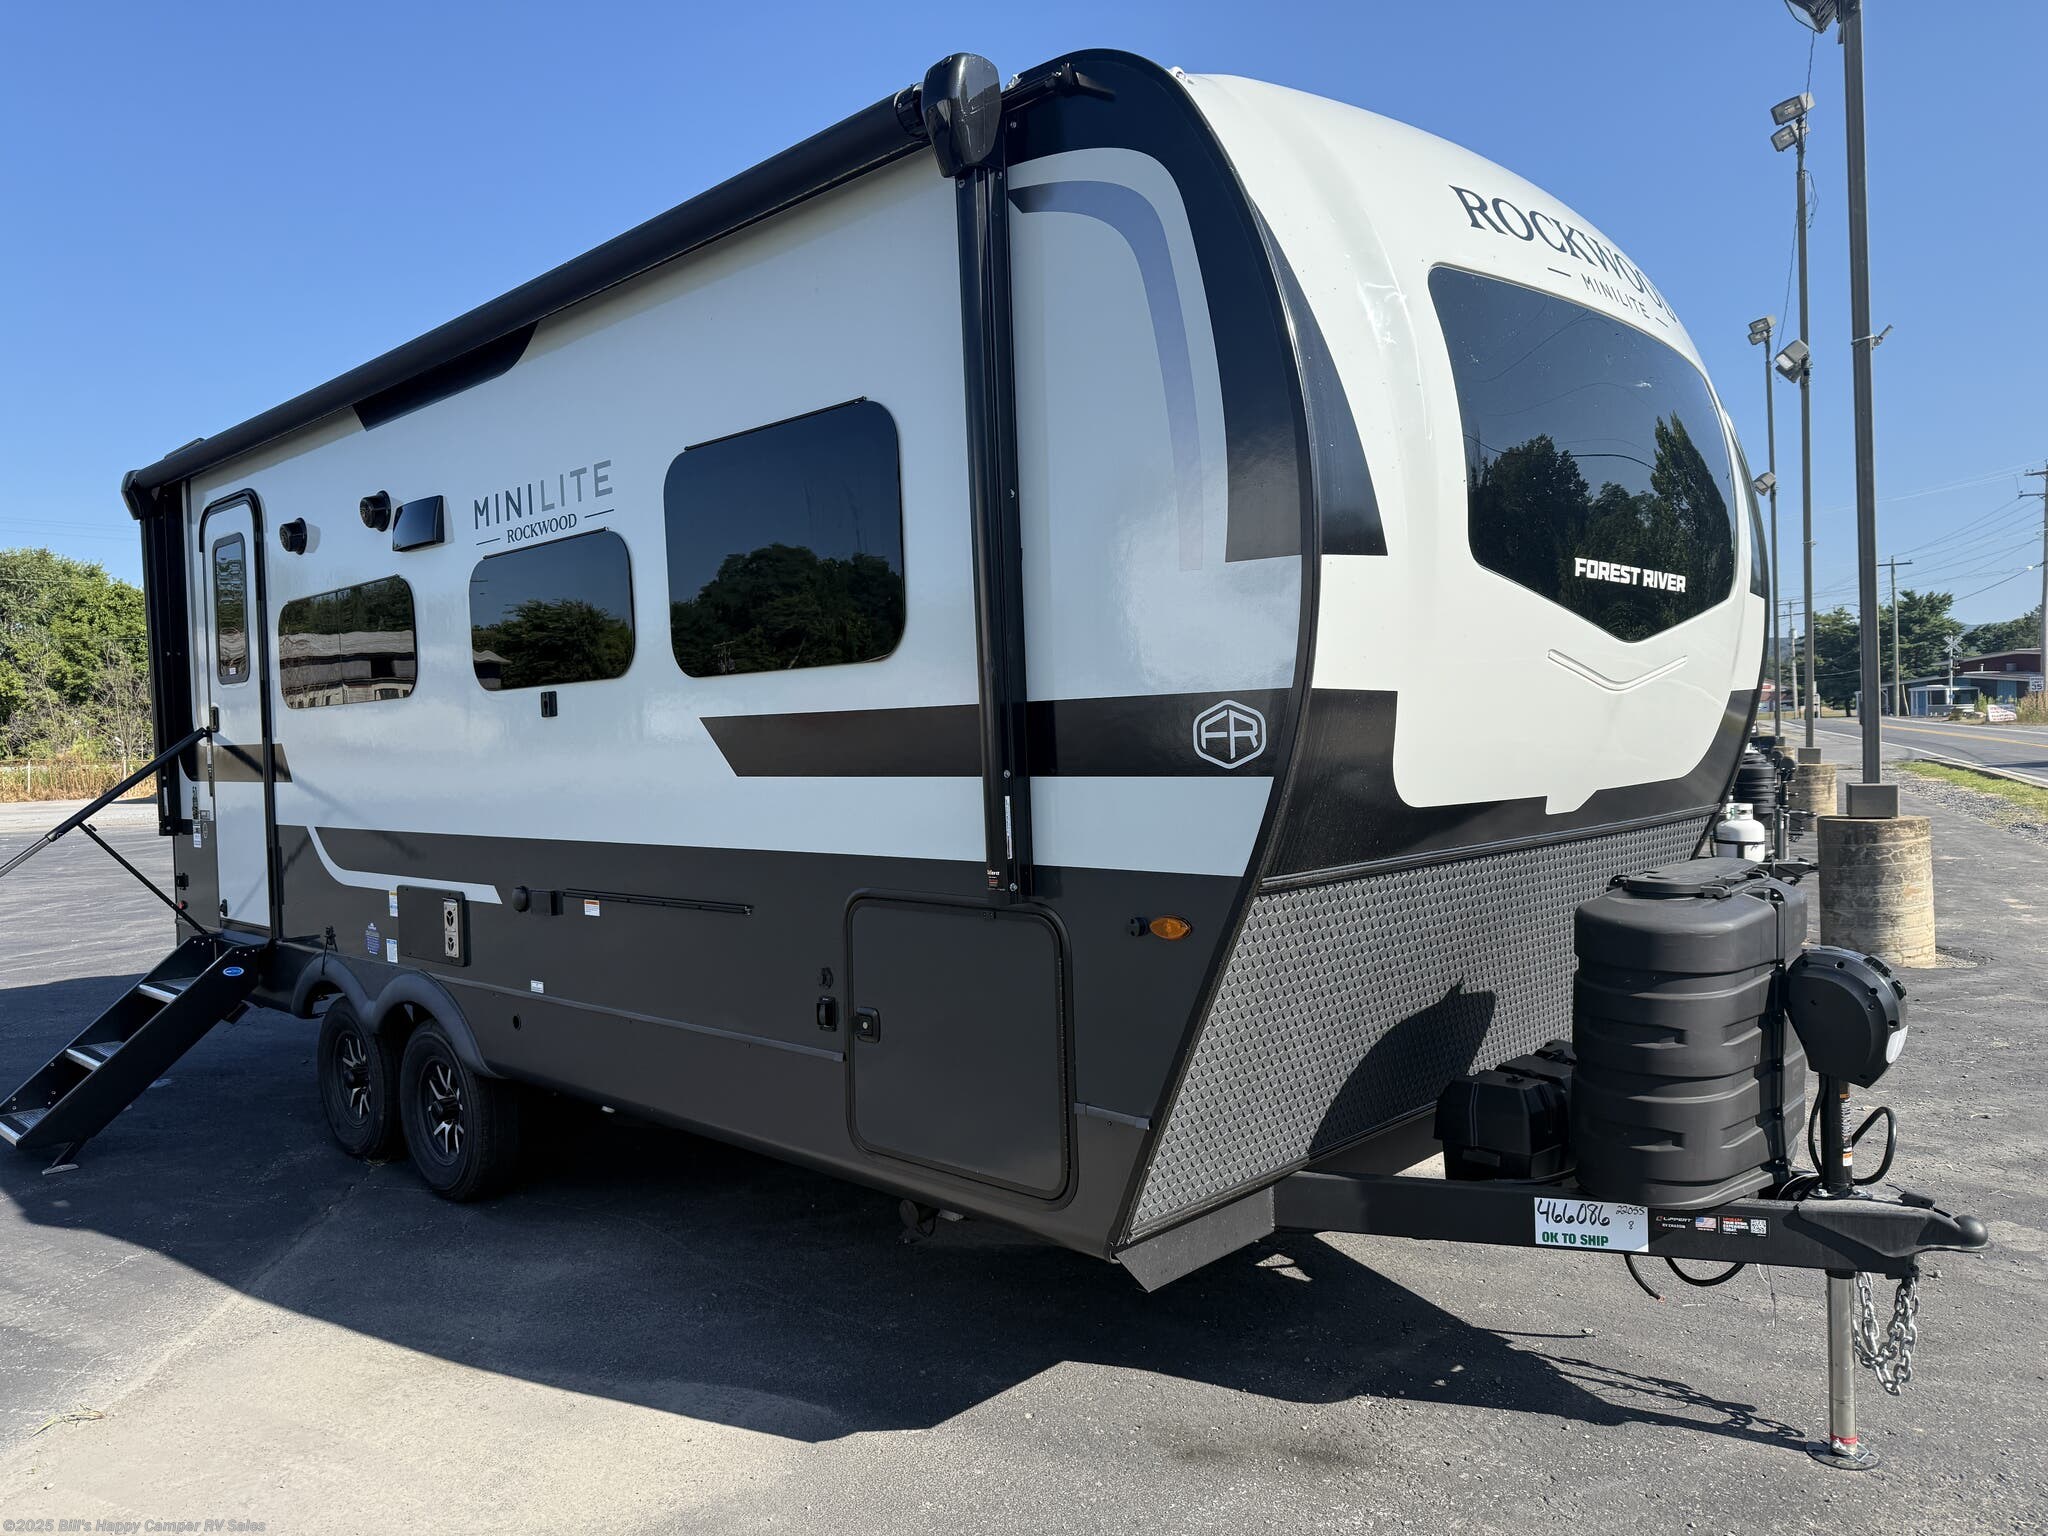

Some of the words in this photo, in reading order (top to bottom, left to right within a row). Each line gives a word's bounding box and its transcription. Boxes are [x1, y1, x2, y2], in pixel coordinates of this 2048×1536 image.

[1581, 273, 1651, 319] MINILITE
[473, 460, 614, 530] MINILITE
[507, 513, 577, 543] ROCKWOOD
[1574, 557, 1641, 585] FOREST
[1642, 569, 1686, 592] RIVER
[1537, 1199, 1610, 1226] 466086
[1542, 1231, 1558, 1243] OK
[1562, 1233, 1576, 1244] TO
[1580, 1234, 1609, 1246] SHIP
